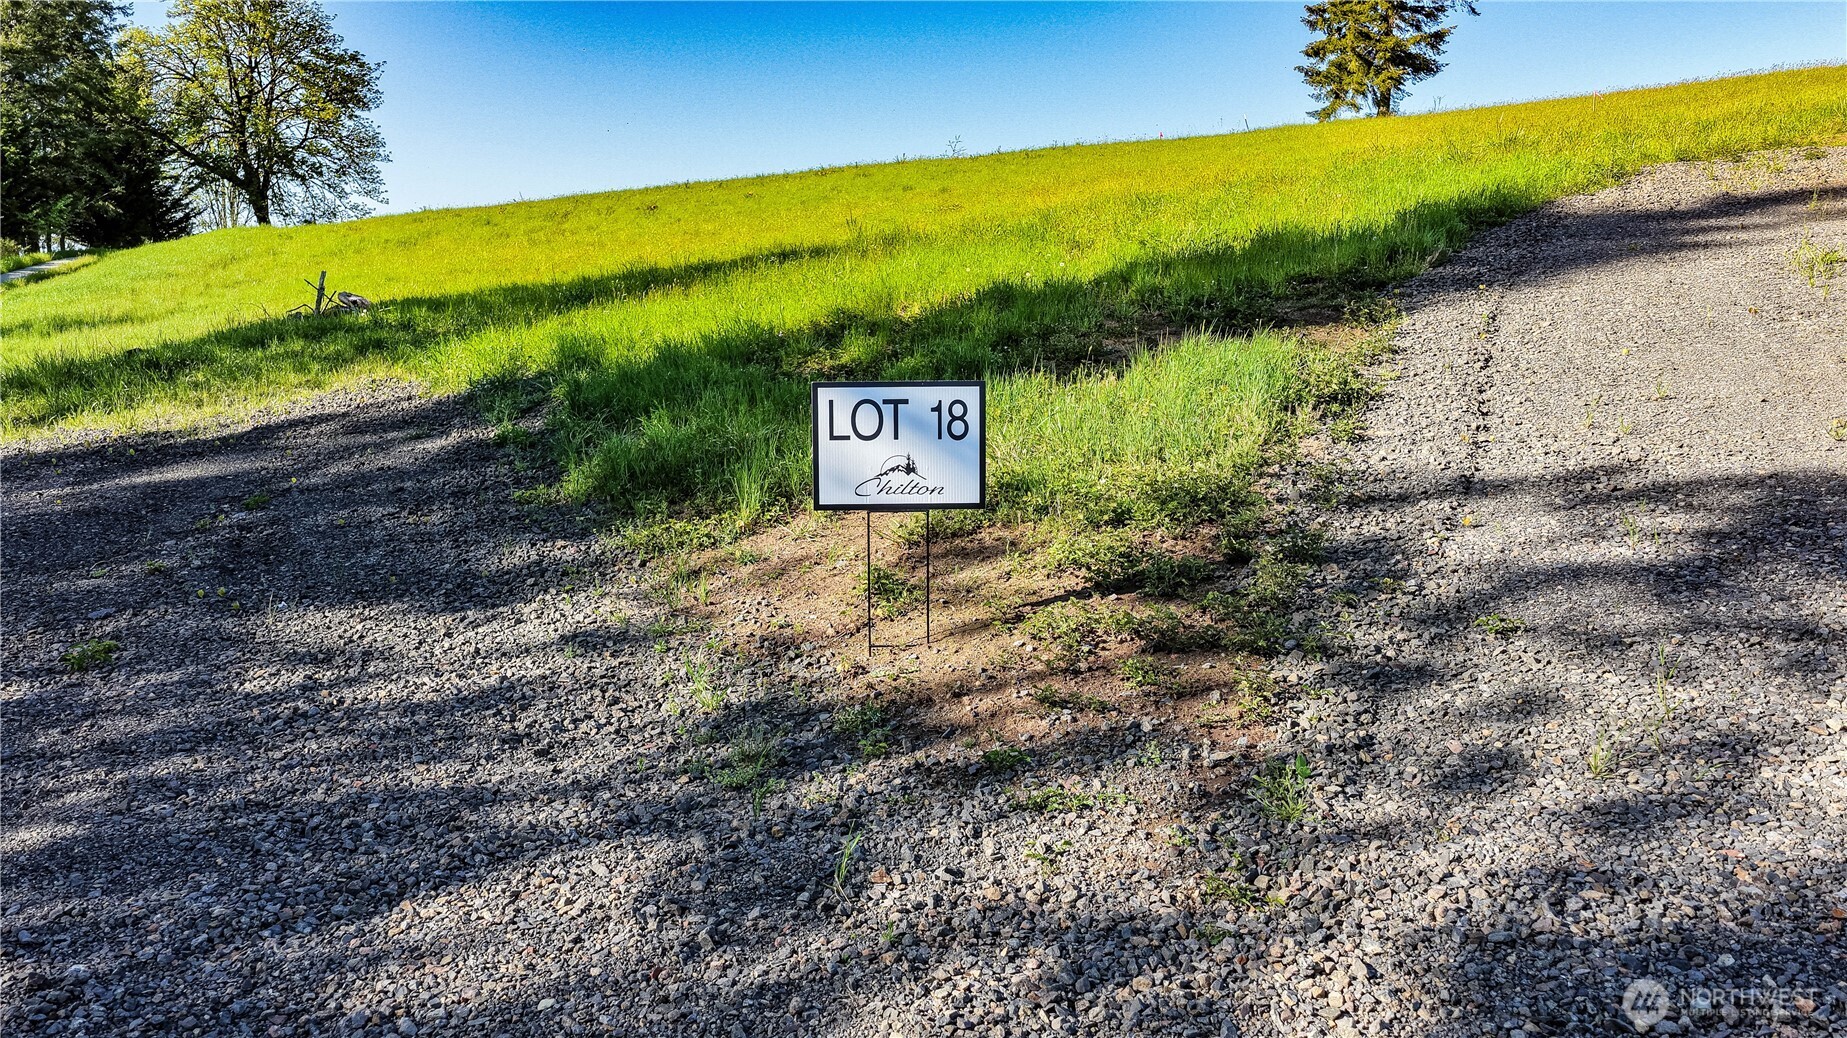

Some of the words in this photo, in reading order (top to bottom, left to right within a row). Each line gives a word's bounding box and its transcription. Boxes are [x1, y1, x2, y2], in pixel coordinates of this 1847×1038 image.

[828, 398, 909, 441] LOT
[930, 399, 969, 441] 18
[854, 477, 944, 497] Chilton
